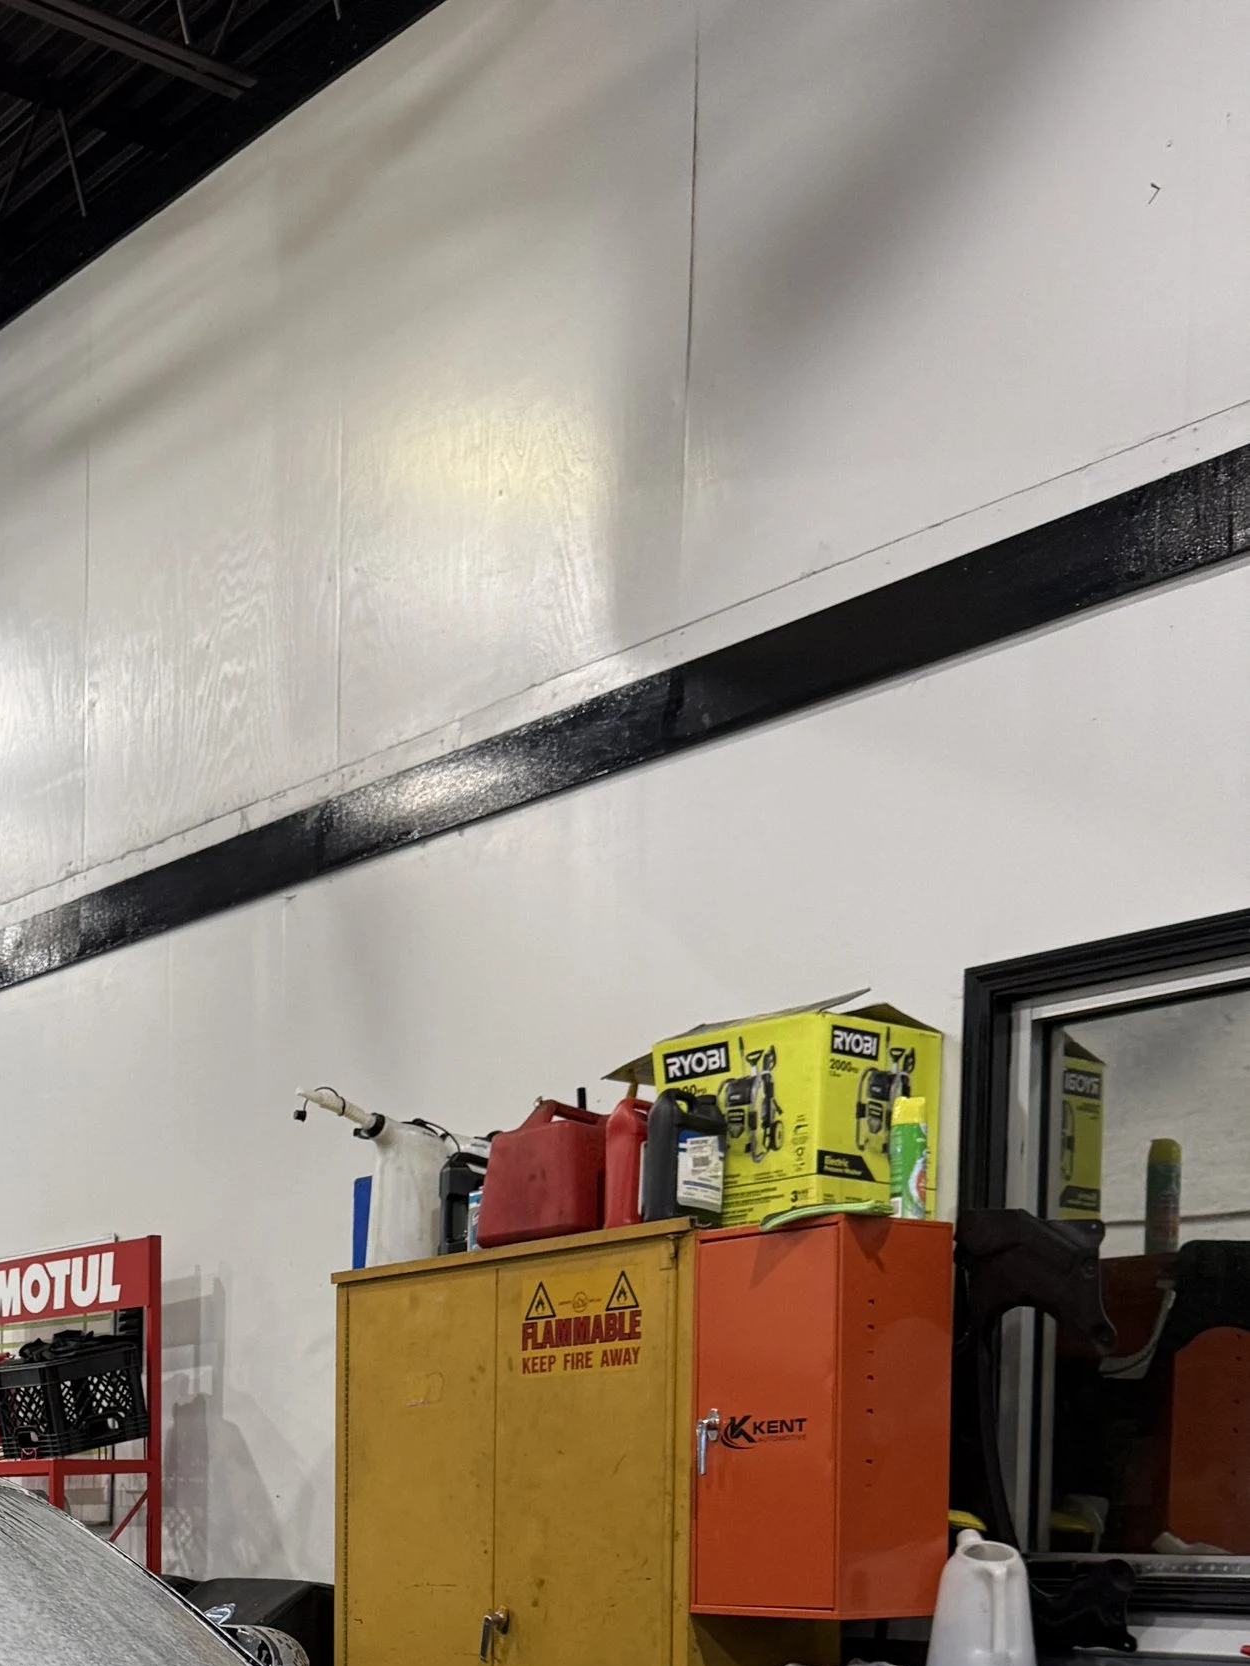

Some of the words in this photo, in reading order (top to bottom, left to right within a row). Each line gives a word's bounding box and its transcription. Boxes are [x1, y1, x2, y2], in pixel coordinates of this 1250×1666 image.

[833, 1030, 878, 1056] RYOBI
[665, 1046, 727, 1078] RYOBI
[521, 1309, 642, 1351] FLAMMABLE
[522, 1355, 556, 1374] KEEP
[563, 1351, 593, 1370] FIRE
[600, 1346, 641, 1367] AWAY
[752, 1418, 807, 1434] KENT
